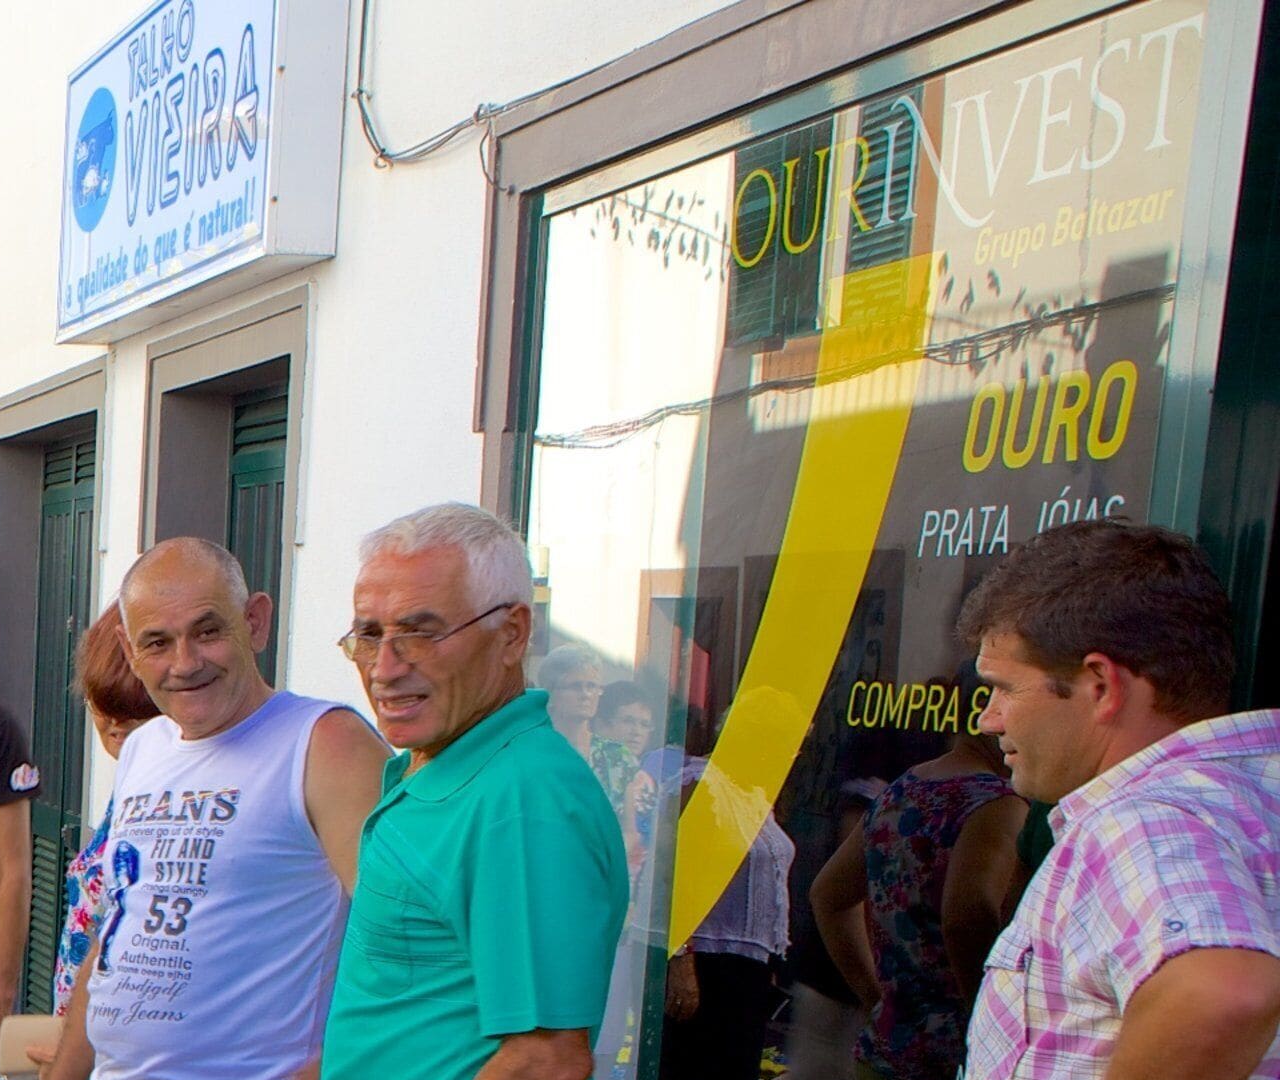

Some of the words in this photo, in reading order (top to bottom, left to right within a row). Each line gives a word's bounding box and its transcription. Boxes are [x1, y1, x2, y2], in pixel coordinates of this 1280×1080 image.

[128, 0, 196, 103] TALHO
[124, 23, 260, 227] VIEIRA
[730, 13, 1205, 269] OURINVEST
[77, 246, 129, 316] qualidade
[134, 234, 149, 276] do
[154, 228, 178, 277] que
[198, 175, 257, 246] natural!
[974, 226, 1046, 269] Grupo
[1051, 187, 1176, 248] Baltazar
[961, 358, 1139, 474] OURO
[918, 504, 1010, 558] PRATA
[847, 680, 960, 734] COMPRA
[113, 788, 241, 827] JEANS
[196, 826, 225, 838] style
[150, 838, 177, 859] FIT
[178, 838, 216, 860] AND
[155, 861, 208, 886] STYLE
[143, 895, 195, 936] 53
[122, 1001, 187, 1025] Jeans
